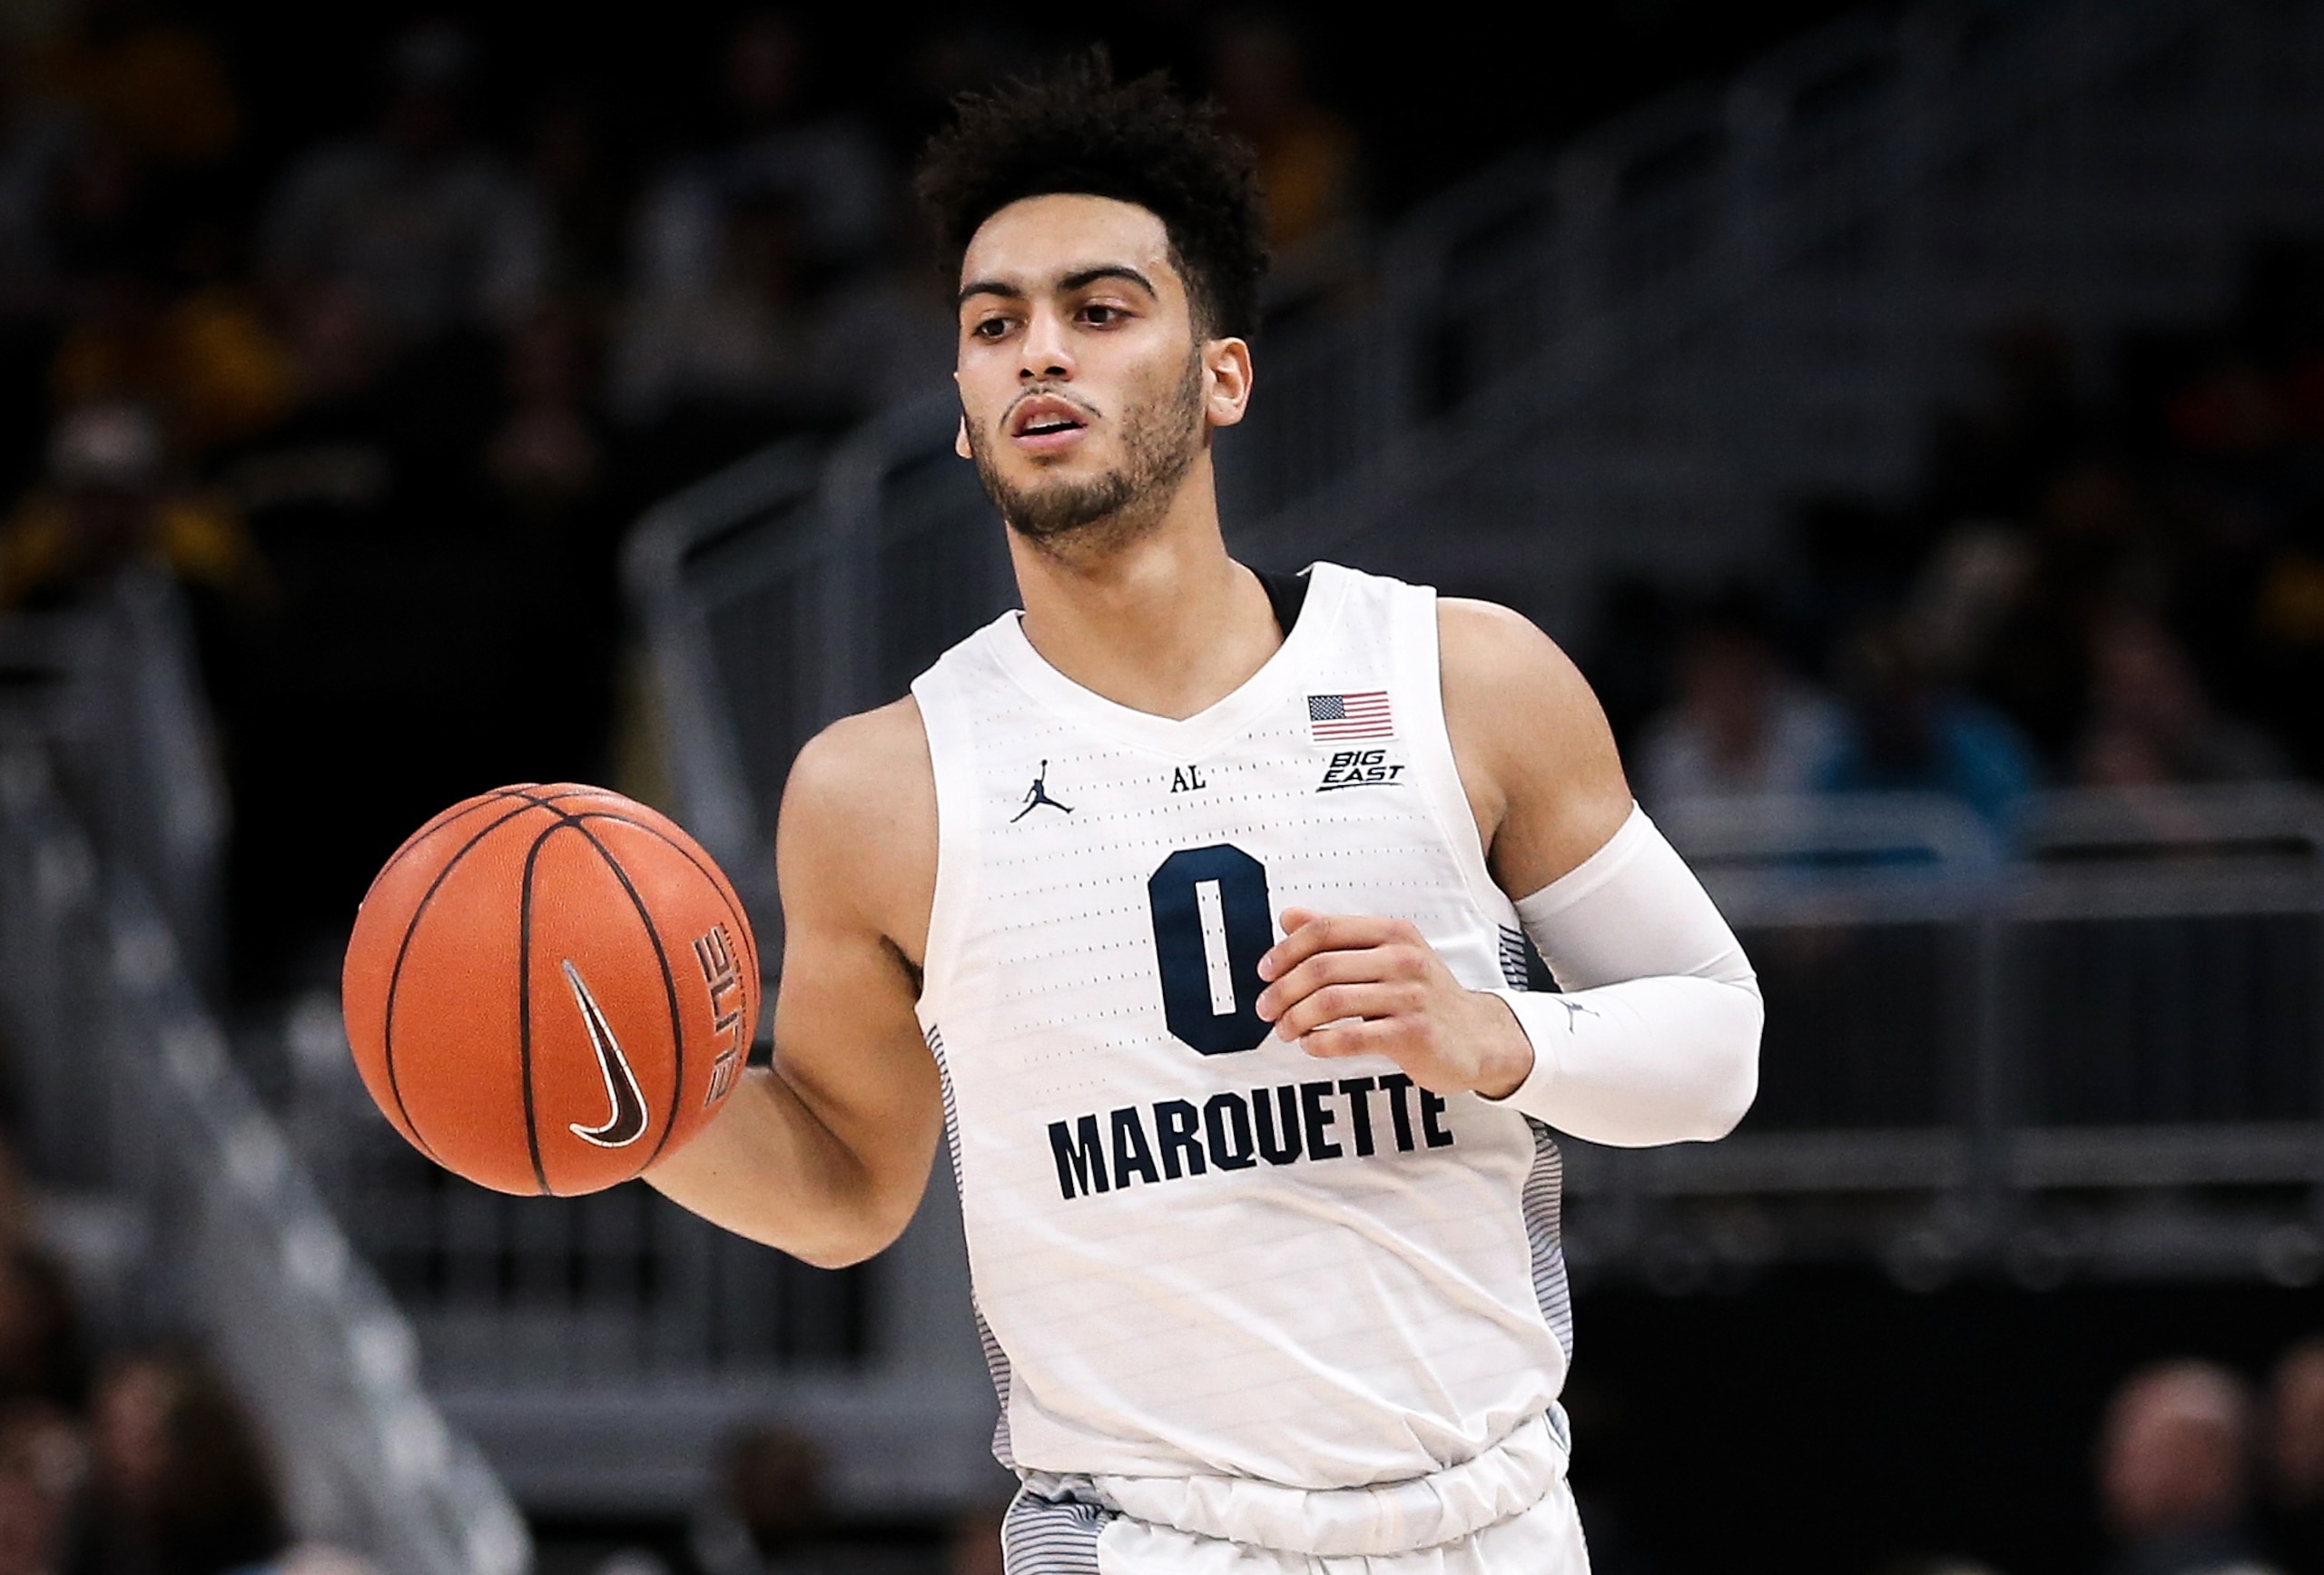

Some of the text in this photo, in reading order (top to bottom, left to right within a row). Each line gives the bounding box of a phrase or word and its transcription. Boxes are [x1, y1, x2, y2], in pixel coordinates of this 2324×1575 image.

[1170, 765, 1206, 792] AL
[1322, 765, 1405, 783] EAST
[1329, 750, 1386, 767] BIG
[1147, 842, 1275, 1056] 0
[692, 925, 740, 1107] ELITE
[1047, 1073, 1454, 1200] MARQUETTE
